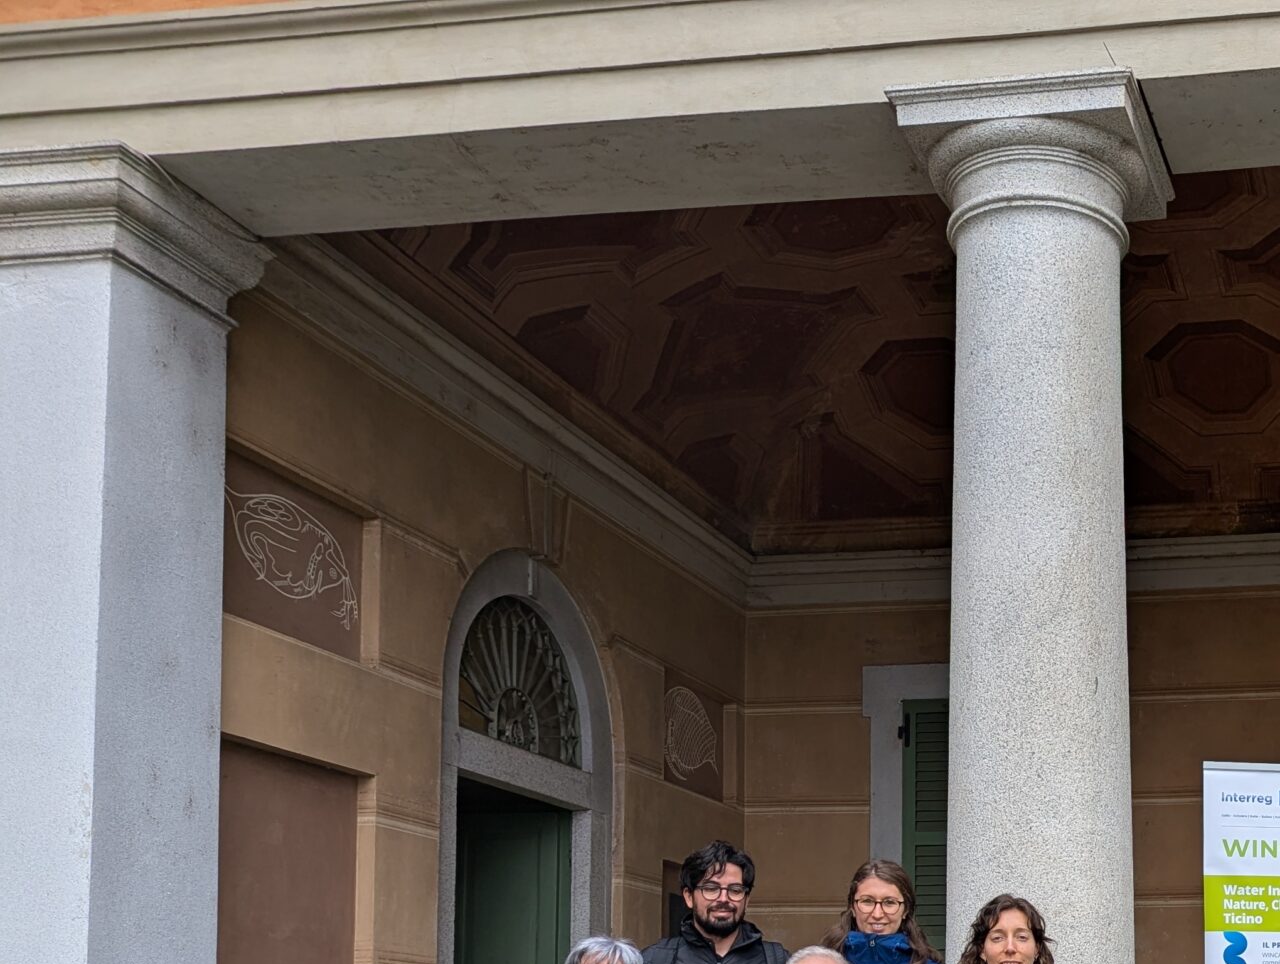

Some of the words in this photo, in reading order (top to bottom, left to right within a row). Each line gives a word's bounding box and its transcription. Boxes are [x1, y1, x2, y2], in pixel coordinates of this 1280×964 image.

[1221, 791, 1273, 805] Interreg
[1223, 884, 1265, 896] Water
[1223, 898, 1269, 912] Nature,
[1223, 912, 1263, 924] Ticino
[1262, 941, 1270, 949] IL
